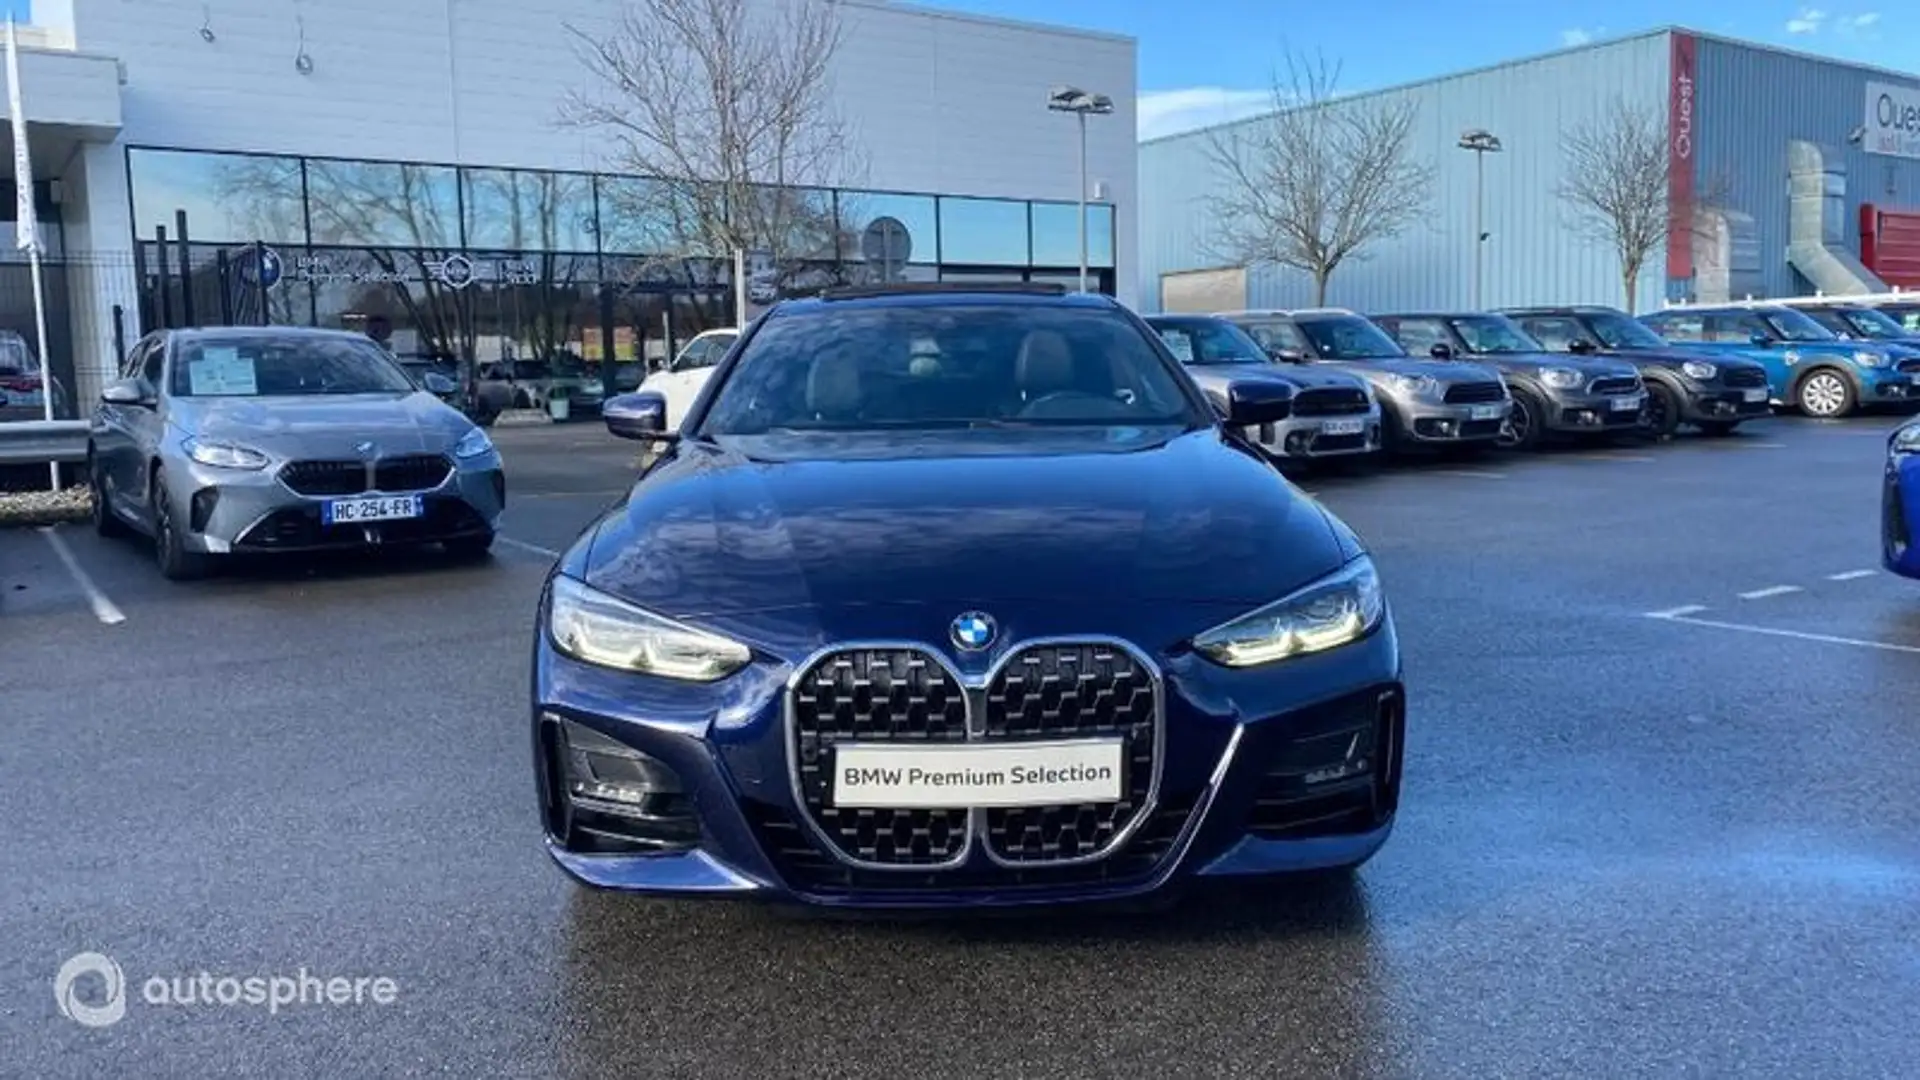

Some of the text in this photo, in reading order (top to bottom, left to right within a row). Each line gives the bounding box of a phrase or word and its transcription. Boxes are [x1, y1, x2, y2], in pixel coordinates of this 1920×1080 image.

[843, 763, 1112, 786] BMW Premium Selection
